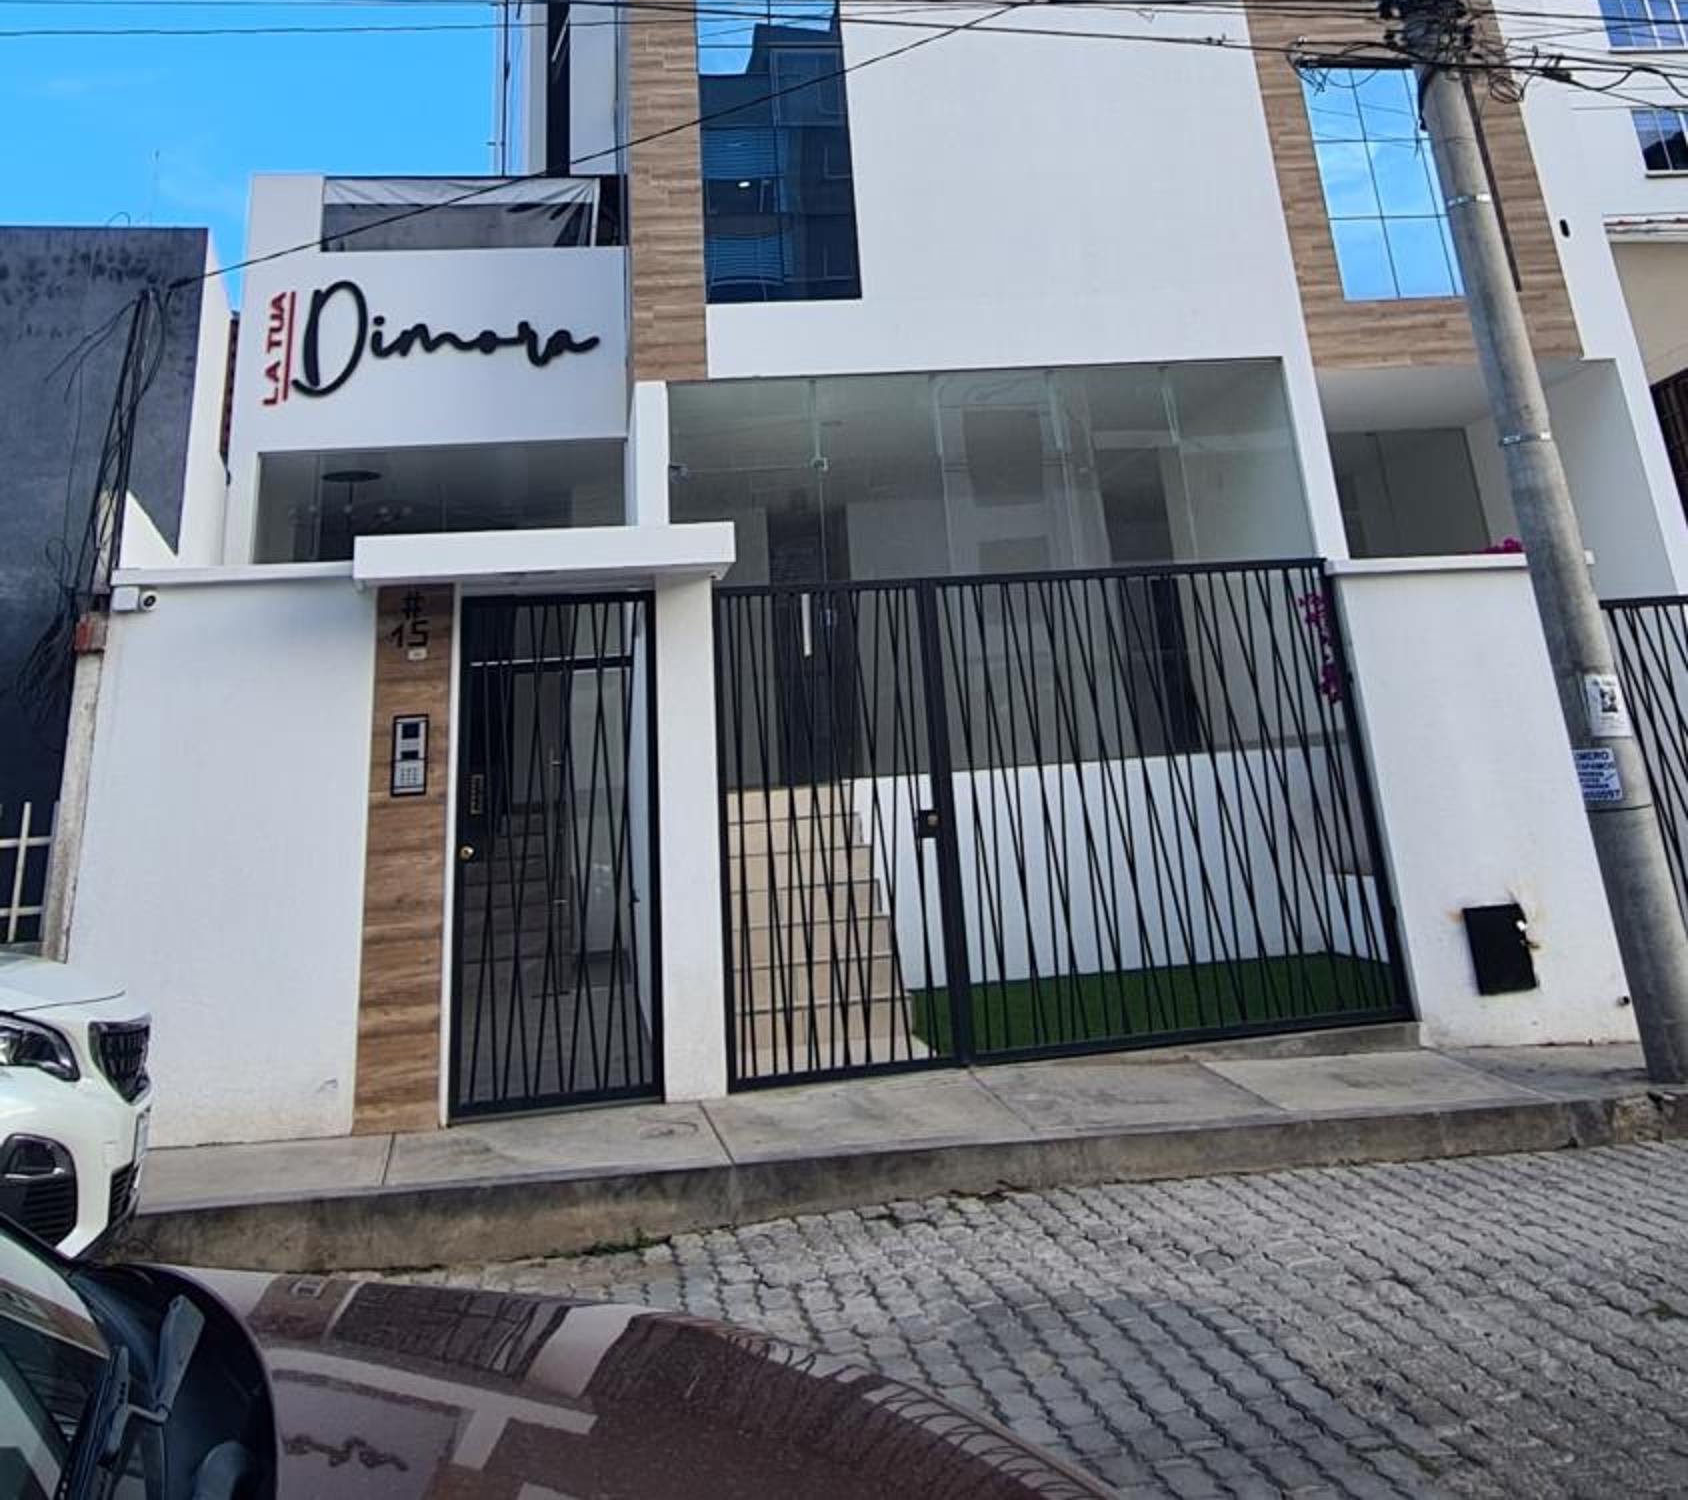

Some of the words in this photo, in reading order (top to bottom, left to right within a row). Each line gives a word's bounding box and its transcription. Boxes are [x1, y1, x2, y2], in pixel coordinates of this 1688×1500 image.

[267, 292, 288, 353] TUA
[291, 280, 600, 396] Dimora
[262, 360, 281, 406] LA
[391, 620, 428, 647] 15
